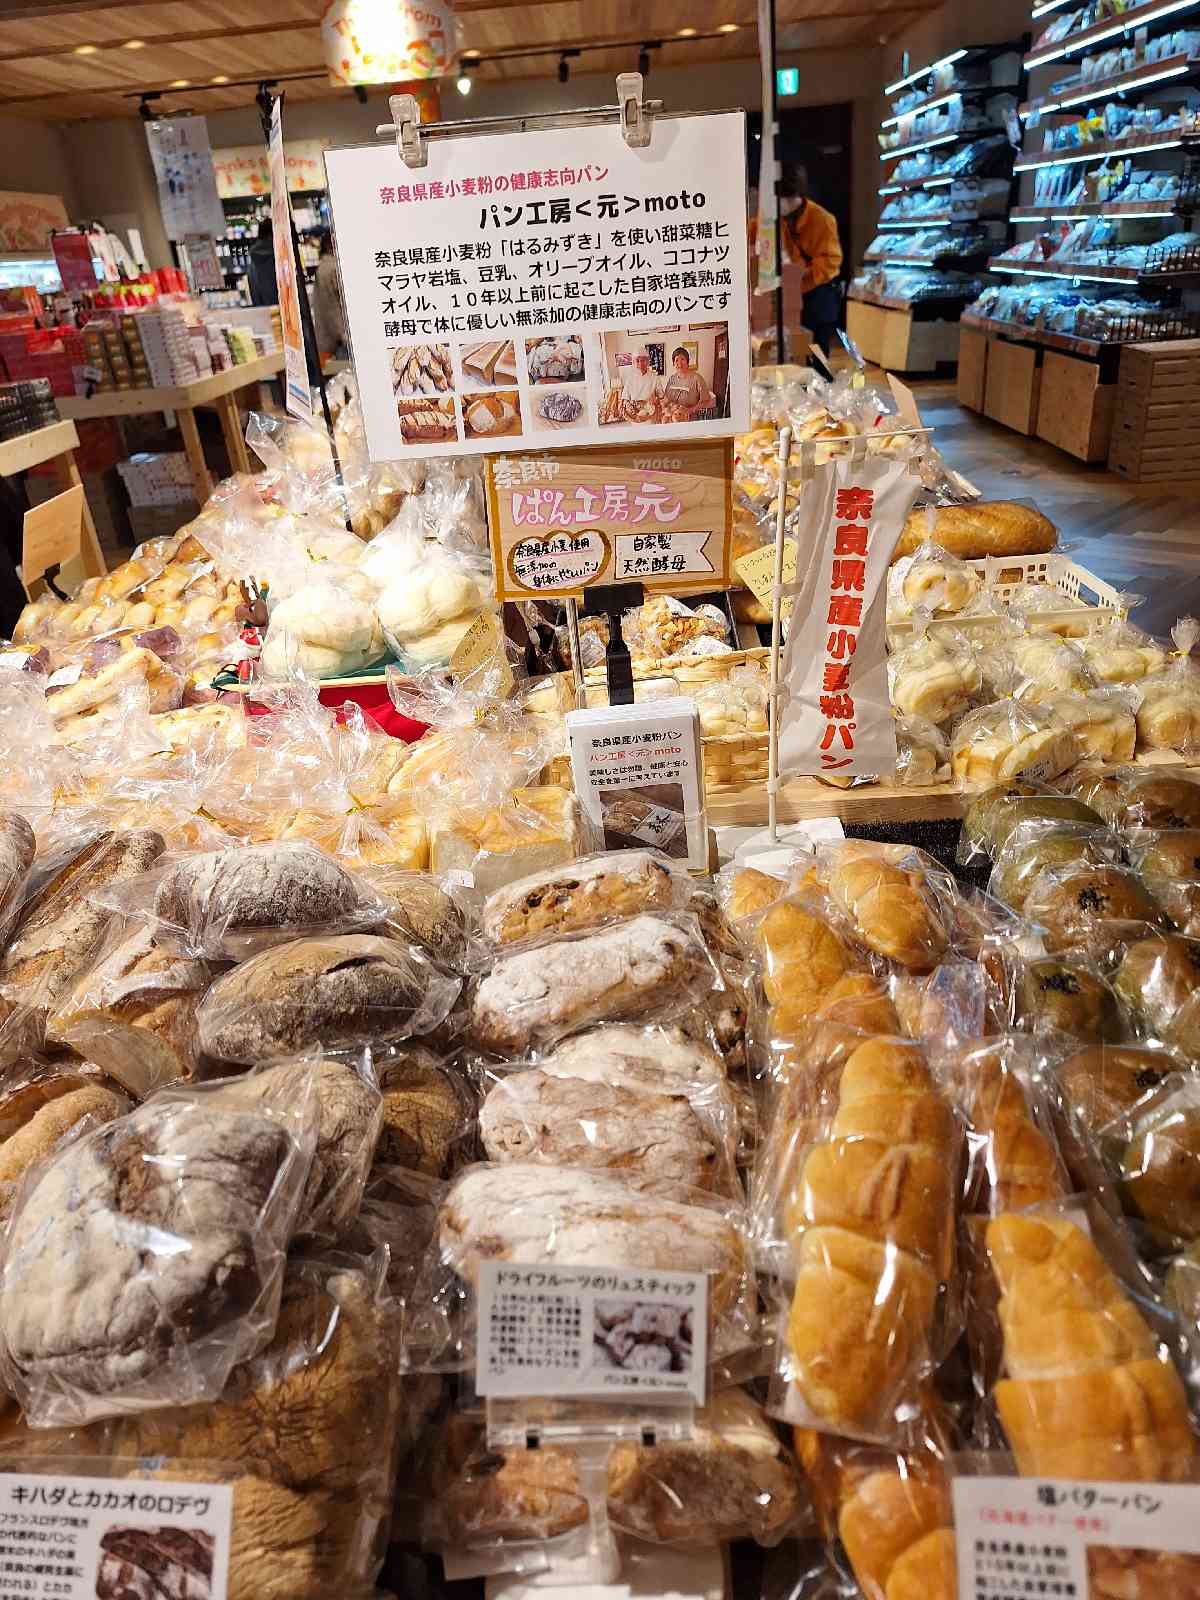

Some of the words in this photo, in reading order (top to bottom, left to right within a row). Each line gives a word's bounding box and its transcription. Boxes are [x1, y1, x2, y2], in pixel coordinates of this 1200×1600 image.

[380, 166, 609, 206] 奈良県産小麦粉の健康志向パン
[375, 222, 729, 269] 奈良県産小麦粉「はるみずき」を使い甜菜糖ヒ
[378, 244, 730, 291] マラヤ岩塩、豆乳、オリーブオイル、ココナツ
[385, 292, 729, 338] 酵母で体に優しい無添加の健康志向のパンです
[493, 454, 560, 489] 奈良市
[633, 456, 682, 471] moto
[511, 481, 682, 527] ぱん工房元
[633, 534, 672, 552] 自家製
[623, 553, 687, 575] 天然酵母
[819, 486, 875, 770] 奈良県産小麦粉パン
[592, 731, 682, 748] 奈良県産小麦粉パン
[497, 1271, 696, 1296] ドライフルーツのリュスティック
[12, 1486, 211, 1516] キハダとカカオのロデヴ
